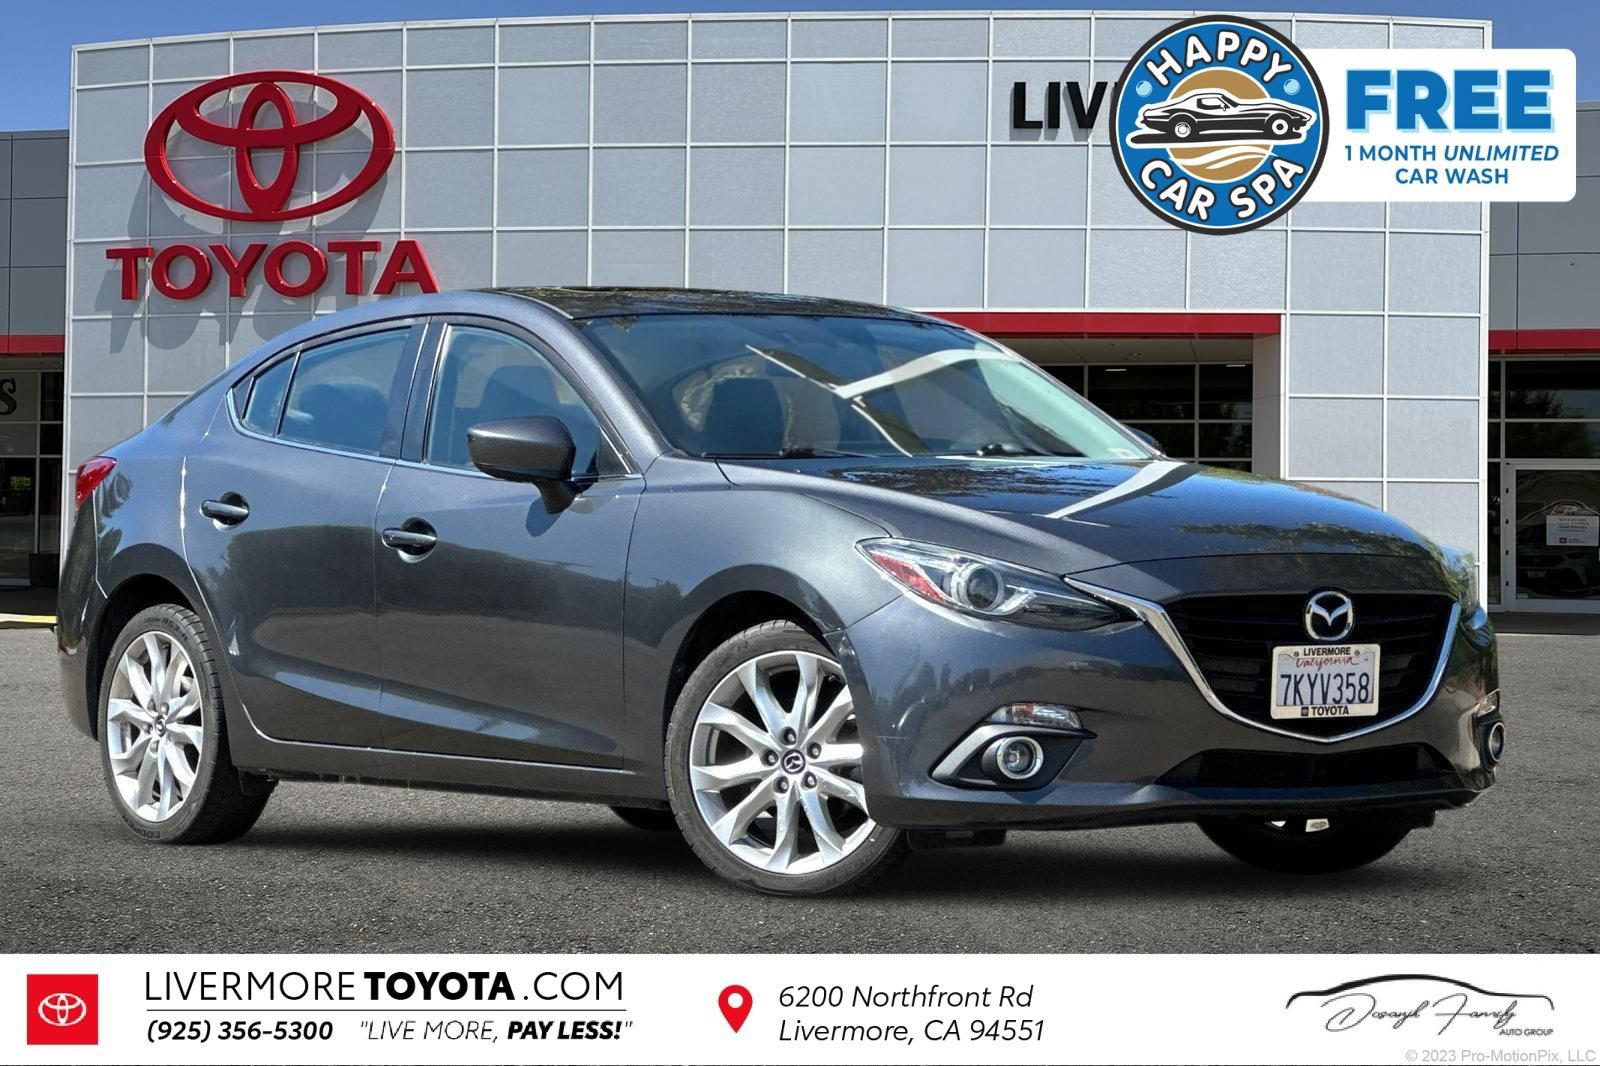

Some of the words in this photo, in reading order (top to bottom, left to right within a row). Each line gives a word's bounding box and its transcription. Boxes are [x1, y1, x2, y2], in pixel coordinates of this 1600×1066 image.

[1013, 81, 1119, 129] LIV
[106, 240, 439, 300] TOYOTA
[1296, 656, 1359, 671] California
[1303, 647, 1351, 656] LIVERMORE
[1280, 672, 1370, 706] 7KYV358
[1311, 706, 1349, 716] TOYOTA
